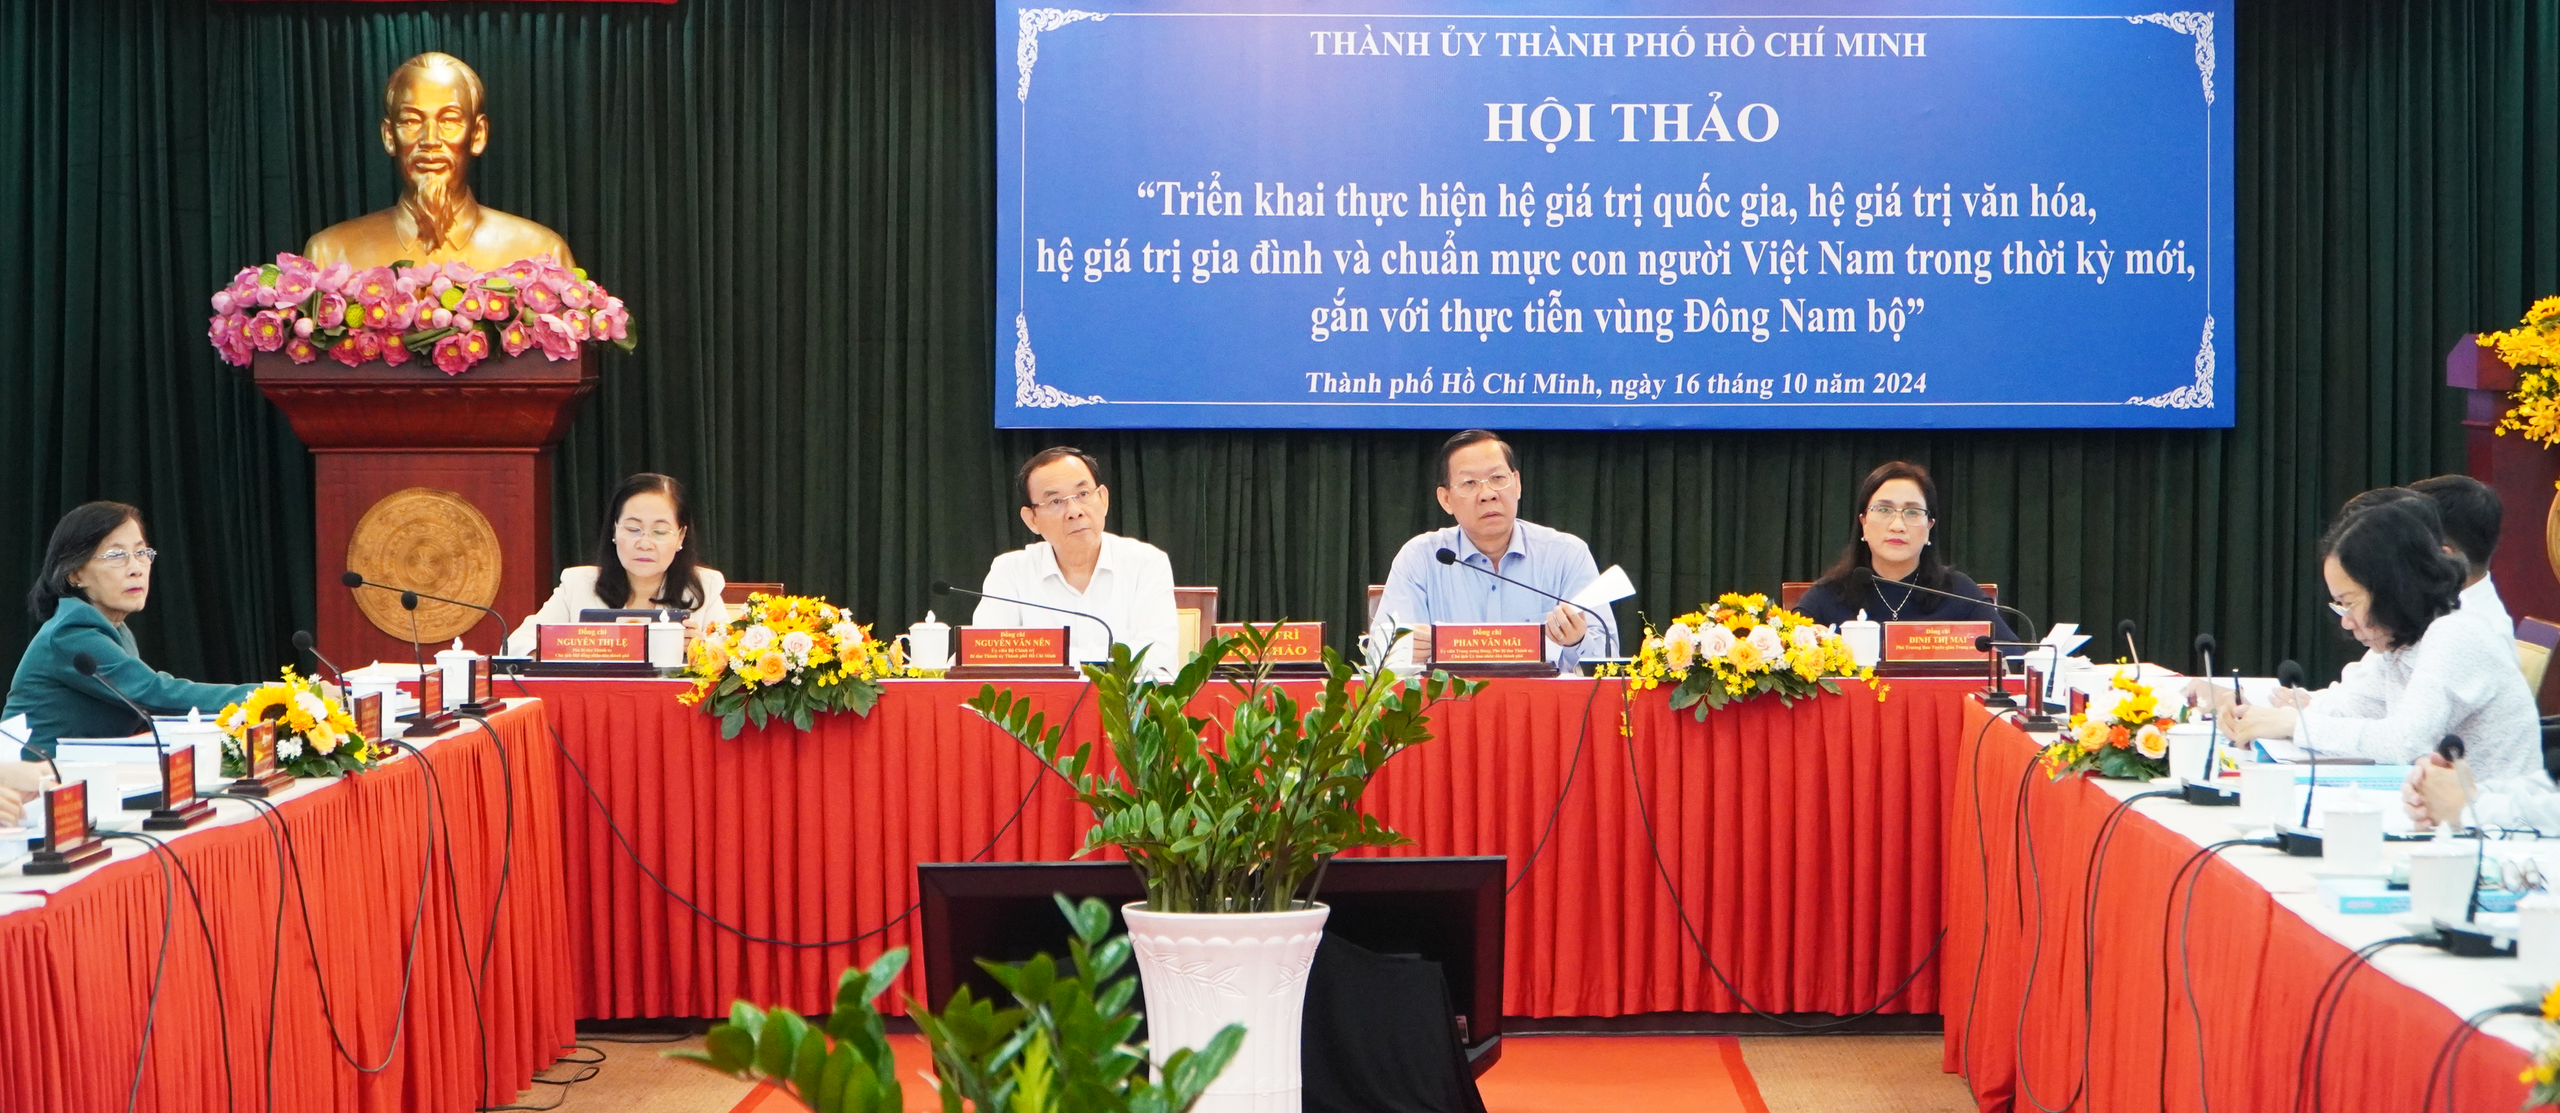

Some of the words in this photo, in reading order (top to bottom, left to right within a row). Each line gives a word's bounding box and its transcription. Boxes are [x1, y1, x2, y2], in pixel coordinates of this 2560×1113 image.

[1309, 23, 1431, 56] THÀNH
[1440, 24, 1487, 57] ỦY
[1495, 25, 1615, 57] THÀNH
[1625, 25, 1696, 58] PHỐ
[1705, 25, 1755, 57] HỒ
[1764, 25, 1825, 57] CHÍ
[1835, 32, 1926, 57] MINH
[1483, 96, 1595, 154] HỘI
[1611, 91, 1779, 143] THẢO
[1137, 170, 1243, 216] “Triển
[1254, 181, 1325, 217] khai
[1335, 182, 1408, 227] thực
[1419, 181, 1487, 228] hiện
[1498, 181, 1535, 227] hệ
[1545, 182, 1593, 228] giá
[1603, 183, 1643, 228] trị
[1653, 172, 1730, 228] quốc
[1741, 182, 1797, 227] gia,
[1808, 181, 1845, 227] hệ
[1855, 182, 1903, 227] giá
[1912, 182, 1952, 227] trị
[1961, 183, 2018, 217] văn
[2030, 182, 2096, 225] hóa,
[1037, 237, 1074, 282] hệ
[1084, 238, 1132, 283] giá
[1141, 238, 1182, 283] trị
[1192, 239, 1240, 284] gia
[1250, 239, 1323, 275] đình
[1333, 239, 1371, 275] và
[1381, 230, 1479, 275] chuẩn
[1491, 250, 1561, 285] mực
[1571, 250, 1627, 276] con
[1638, 240, 1731, 285] người
[1741, 239, 1809, 285] Việt
[1818, 241, 1895, 275] Nam
[1905, 243, 1992, 285] trong
[2002, 240, 2065, 275] thời
[2076, 240, 2114, 284] kỳ
[2126, 239, 2195, 280] mới,
[1311, 287, 1369, 342] gắn
[1379, 297, 1430, 333] với
[1440, 298, 1513, 342] thực
[1523, 289, 1583, 333] tiễn
[1593, 298, 1674, 343] vùng
[1683, 297, 1770, 343] Đông
[1780, 298, 1856, 332] Nam
[1867, 297, 1924, 342] bộ”
[1305, 372, 1381, 393] Thành
[1389, 366, 1433, 399] phố
[1442, 366, 1475, 394] Hồ
[1483, 373, 1526, 394] Chí
[1532, 373, 1602, 399] Minh,
[1610, 373, 1666, 400] ngày
[1674, 373, 1701, 395] 16
[1707, 372, 1774, 400] tháng
[1782, 373, 1809, 395] 10
[1815, 373, 1865, 393] năm
[1873, 372, 1926, 393] 2024
[597, 638, 613, 648] THỊ
[616, 638, 628, 648] LỆ
[1013, 638, 1031, 647] VĂN
[1033, 637, 1051, 647] NÊN
[1481, 637, 1501, 646] VĂN
[1502, 637, 1521, 646] MÃI
[1932, 636, 1948, 645] THỊ
